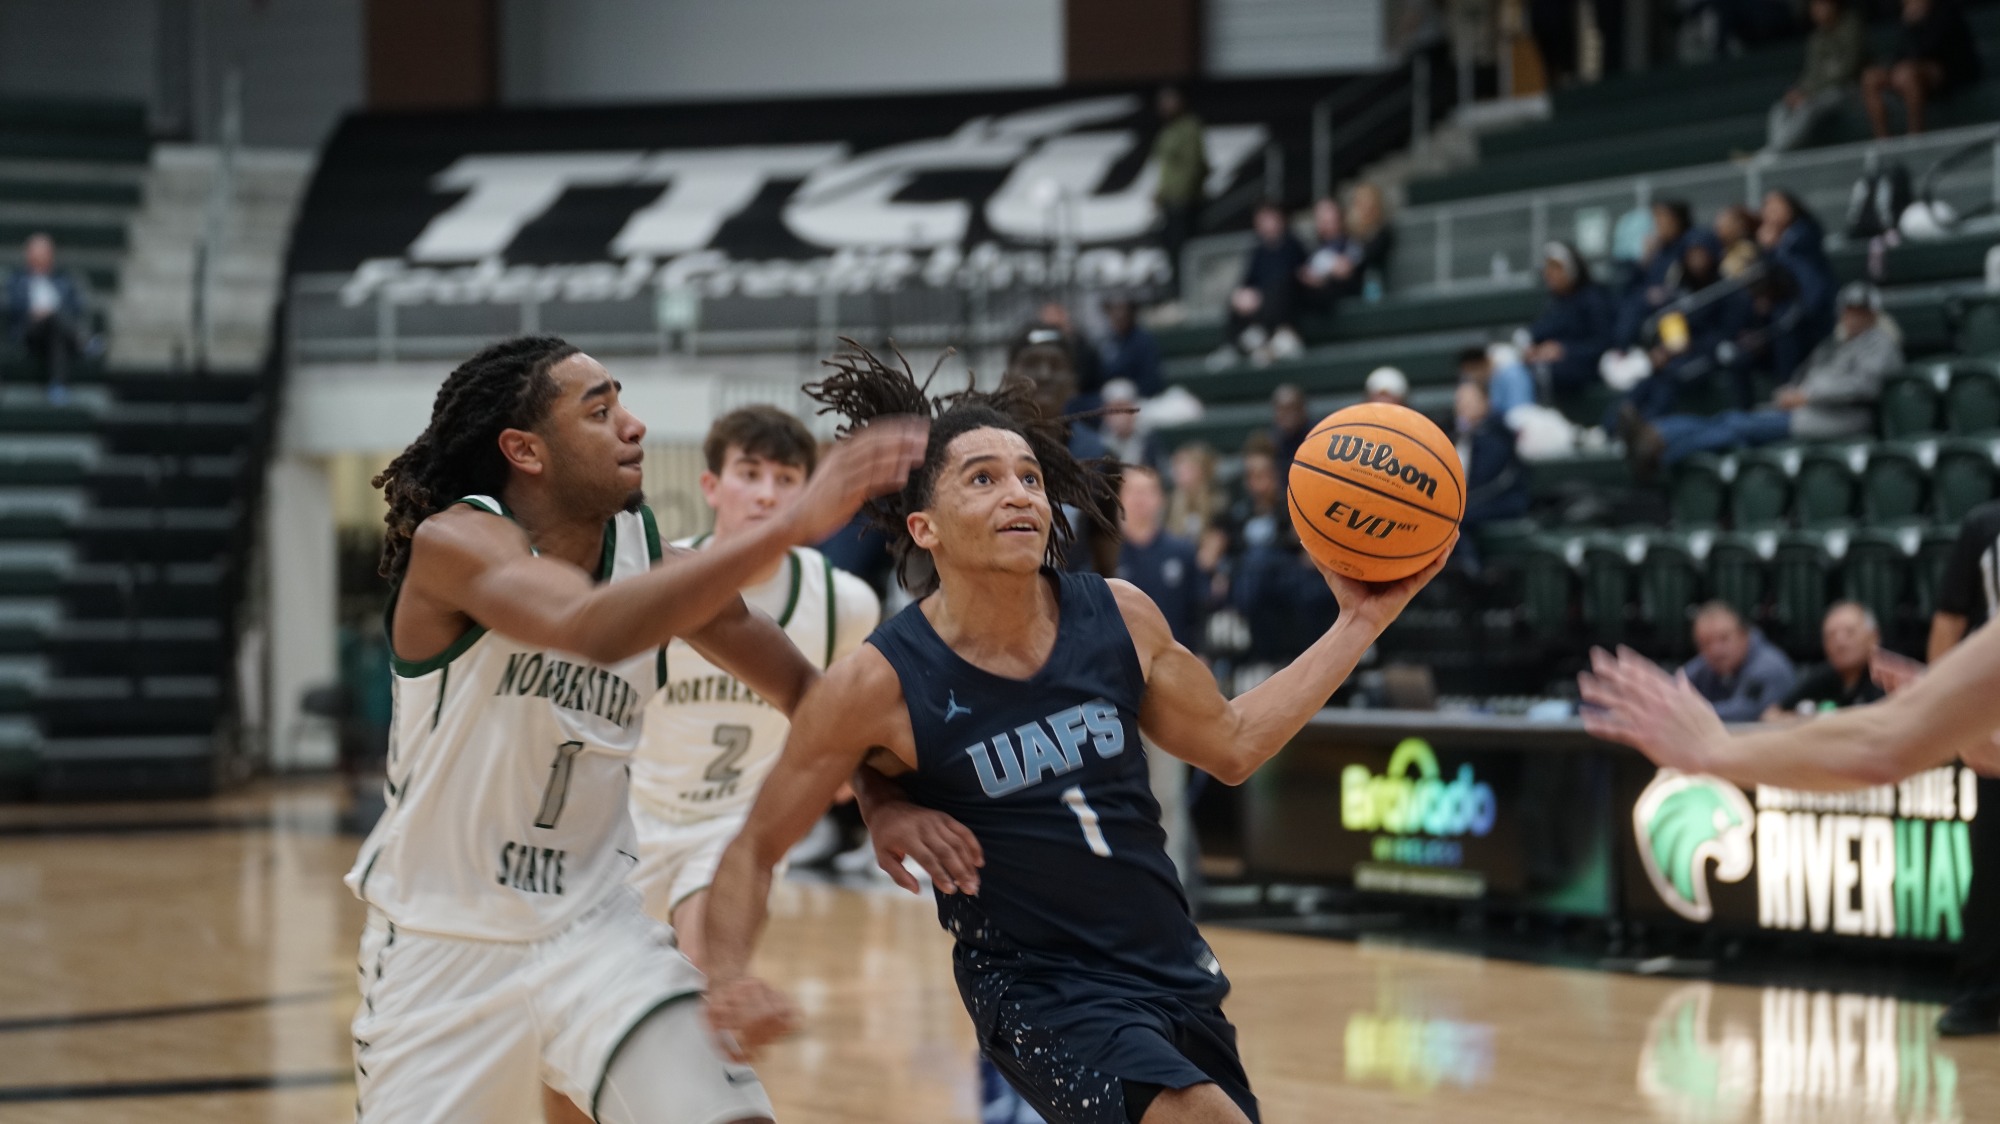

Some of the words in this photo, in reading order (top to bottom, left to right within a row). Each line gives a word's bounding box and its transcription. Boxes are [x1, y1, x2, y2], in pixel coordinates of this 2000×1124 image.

[406, 96, 1270, 260] TTCU
[342, 254, 654, 306] Federal
[1327, 434, 1437, 499] Wilson
[1324, 500, 1397, 539] EVO
[703, 723, 753, 781] 2
[965, 697, 1125, 799] UAFS
[533, 740, 584, 829] 1
[1060, 784, 1113, 858] 1
[497, 841, 565, 895] STATE
